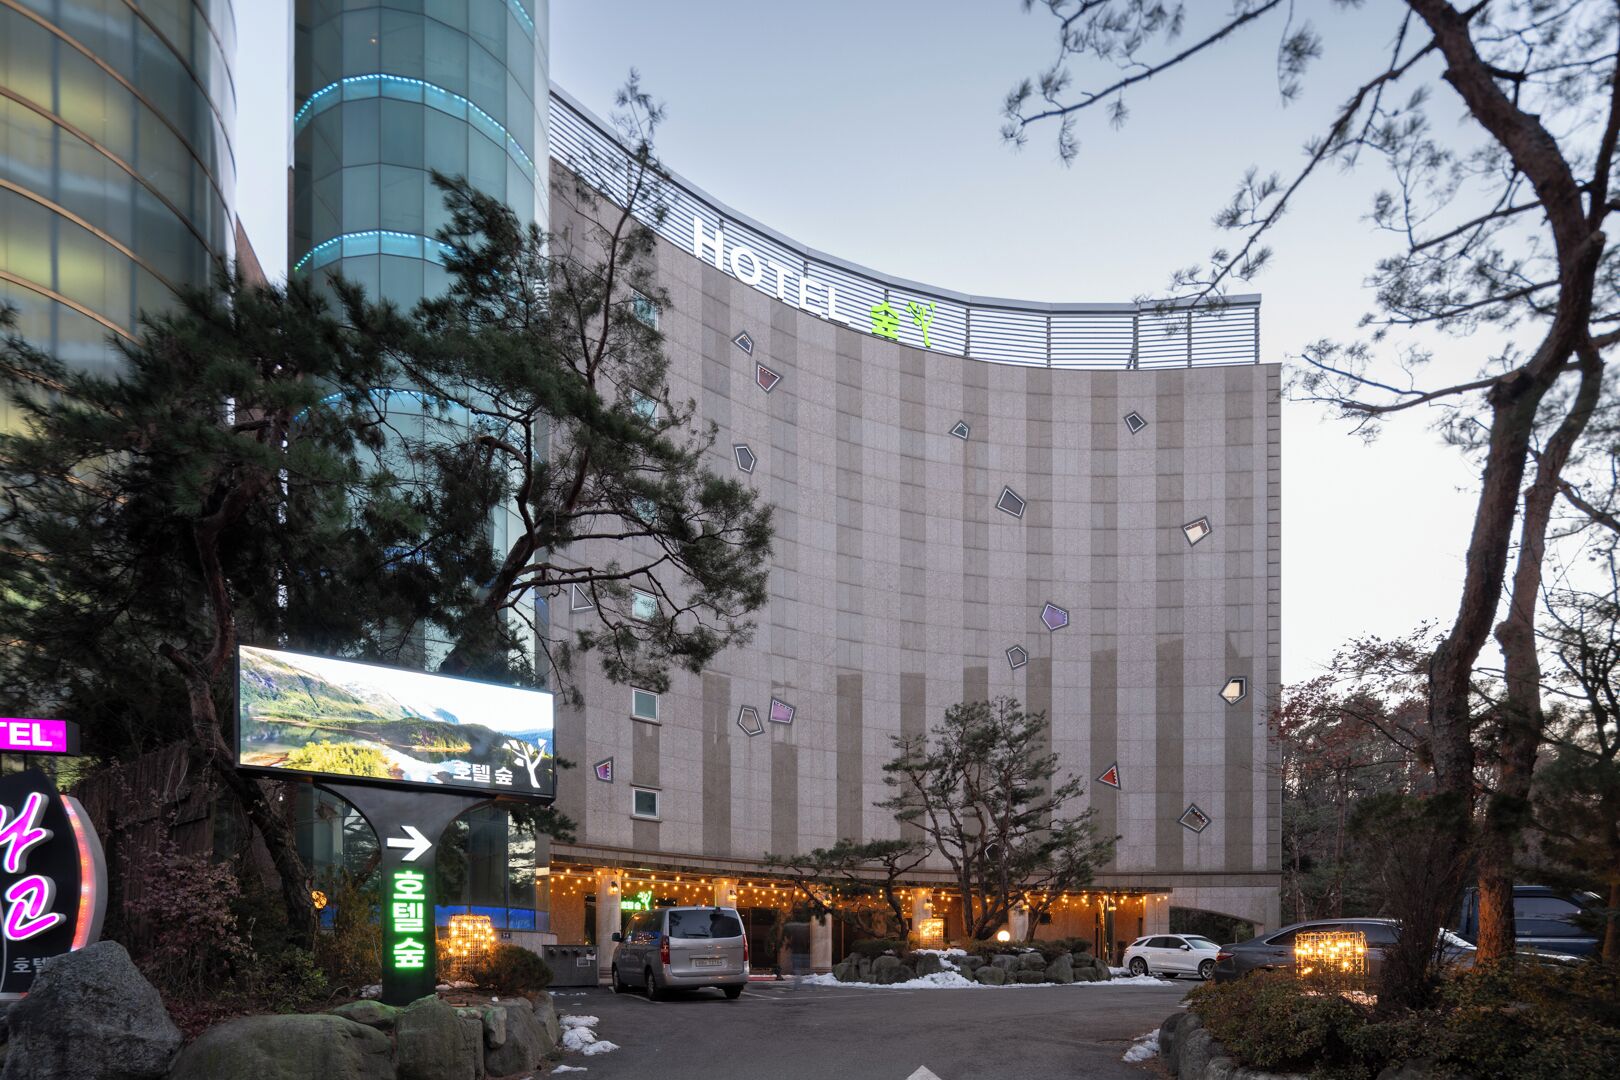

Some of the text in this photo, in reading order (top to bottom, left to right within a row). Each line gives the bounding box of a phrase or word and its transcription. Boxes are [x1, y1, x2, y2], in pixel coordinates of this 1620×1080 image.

[693, 215, 850, 327] HOTEL
[870, 301, 900, 342] 숲
[452, 761, 514, 786] 호텔 숲
[392, 870, 426, 969] 호텔 숲
